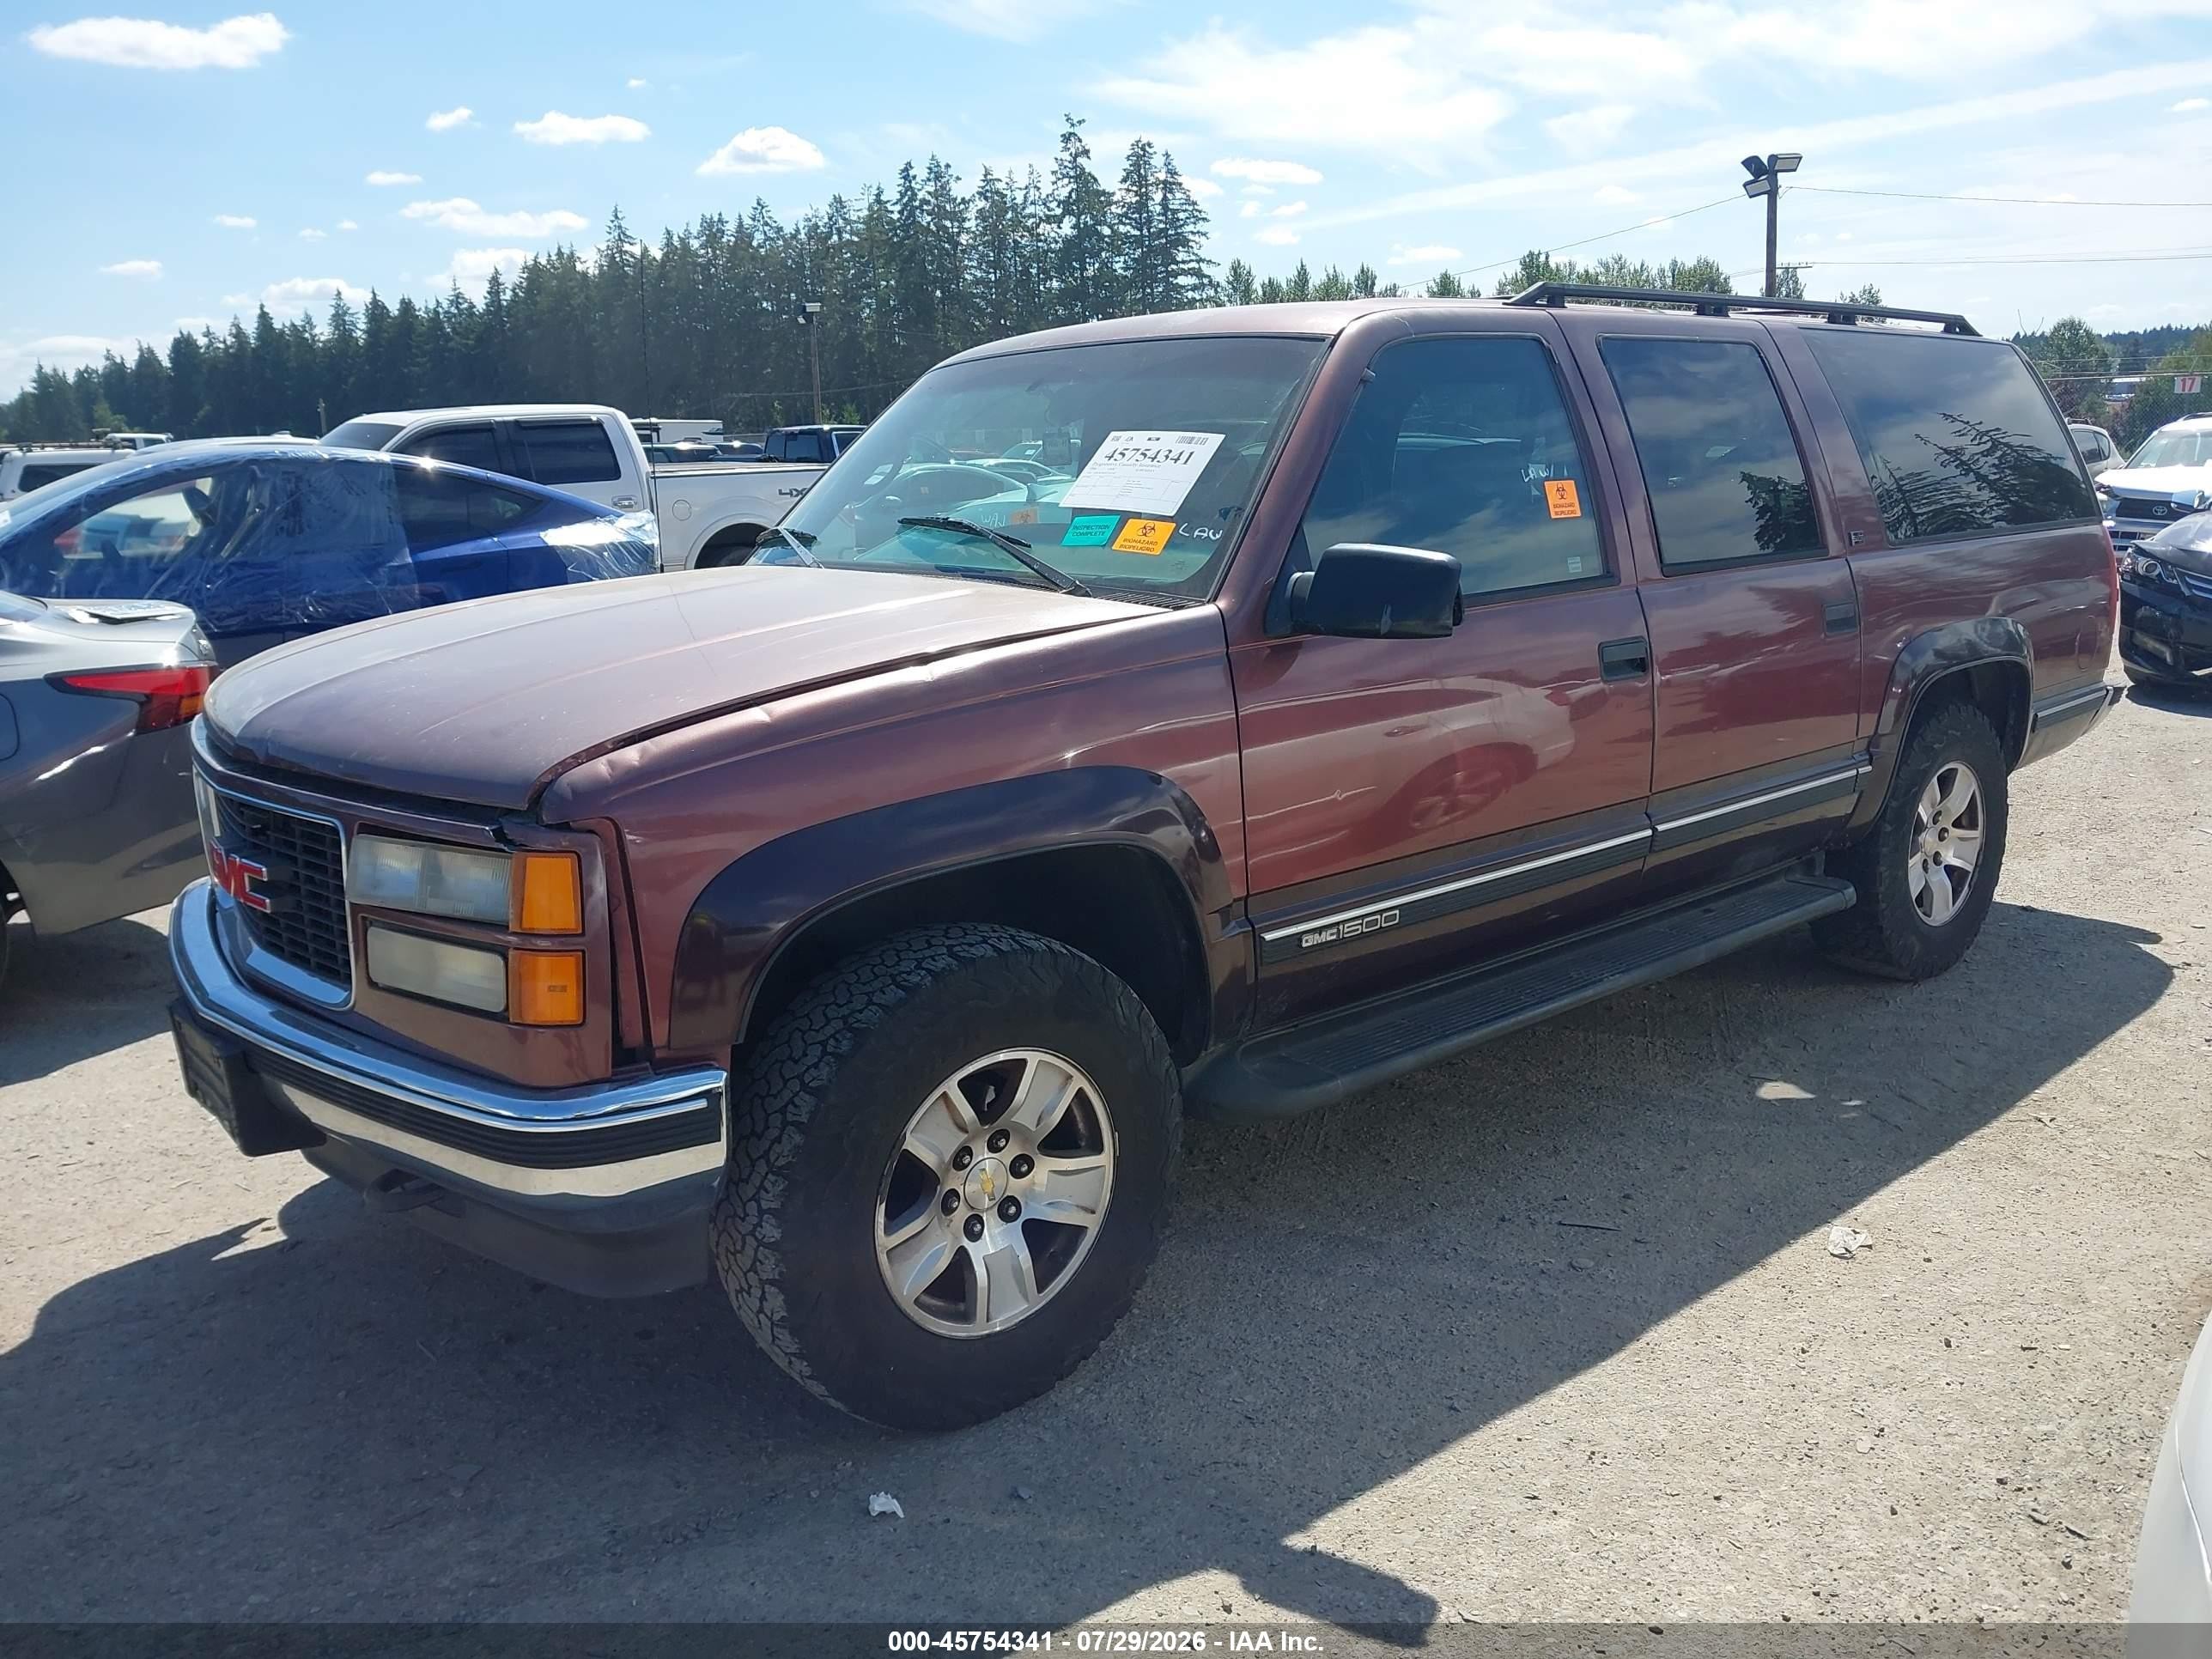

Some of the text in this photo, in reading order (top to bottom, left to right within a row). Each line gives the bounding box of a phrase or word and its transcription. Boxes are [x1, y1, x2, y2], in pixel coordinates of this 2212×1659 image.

[2181, 377, 2197, 392] 17
[1103, 447, 1195, 465] 45754341
[1521, 467, 1550, 483] LAW
[1119, 544, 1155, 552] BIOPELIGRO
[1122, 538, 1158, 546] BIOHAZARD
[1301, 909, 1400, 948] GMC 1500
